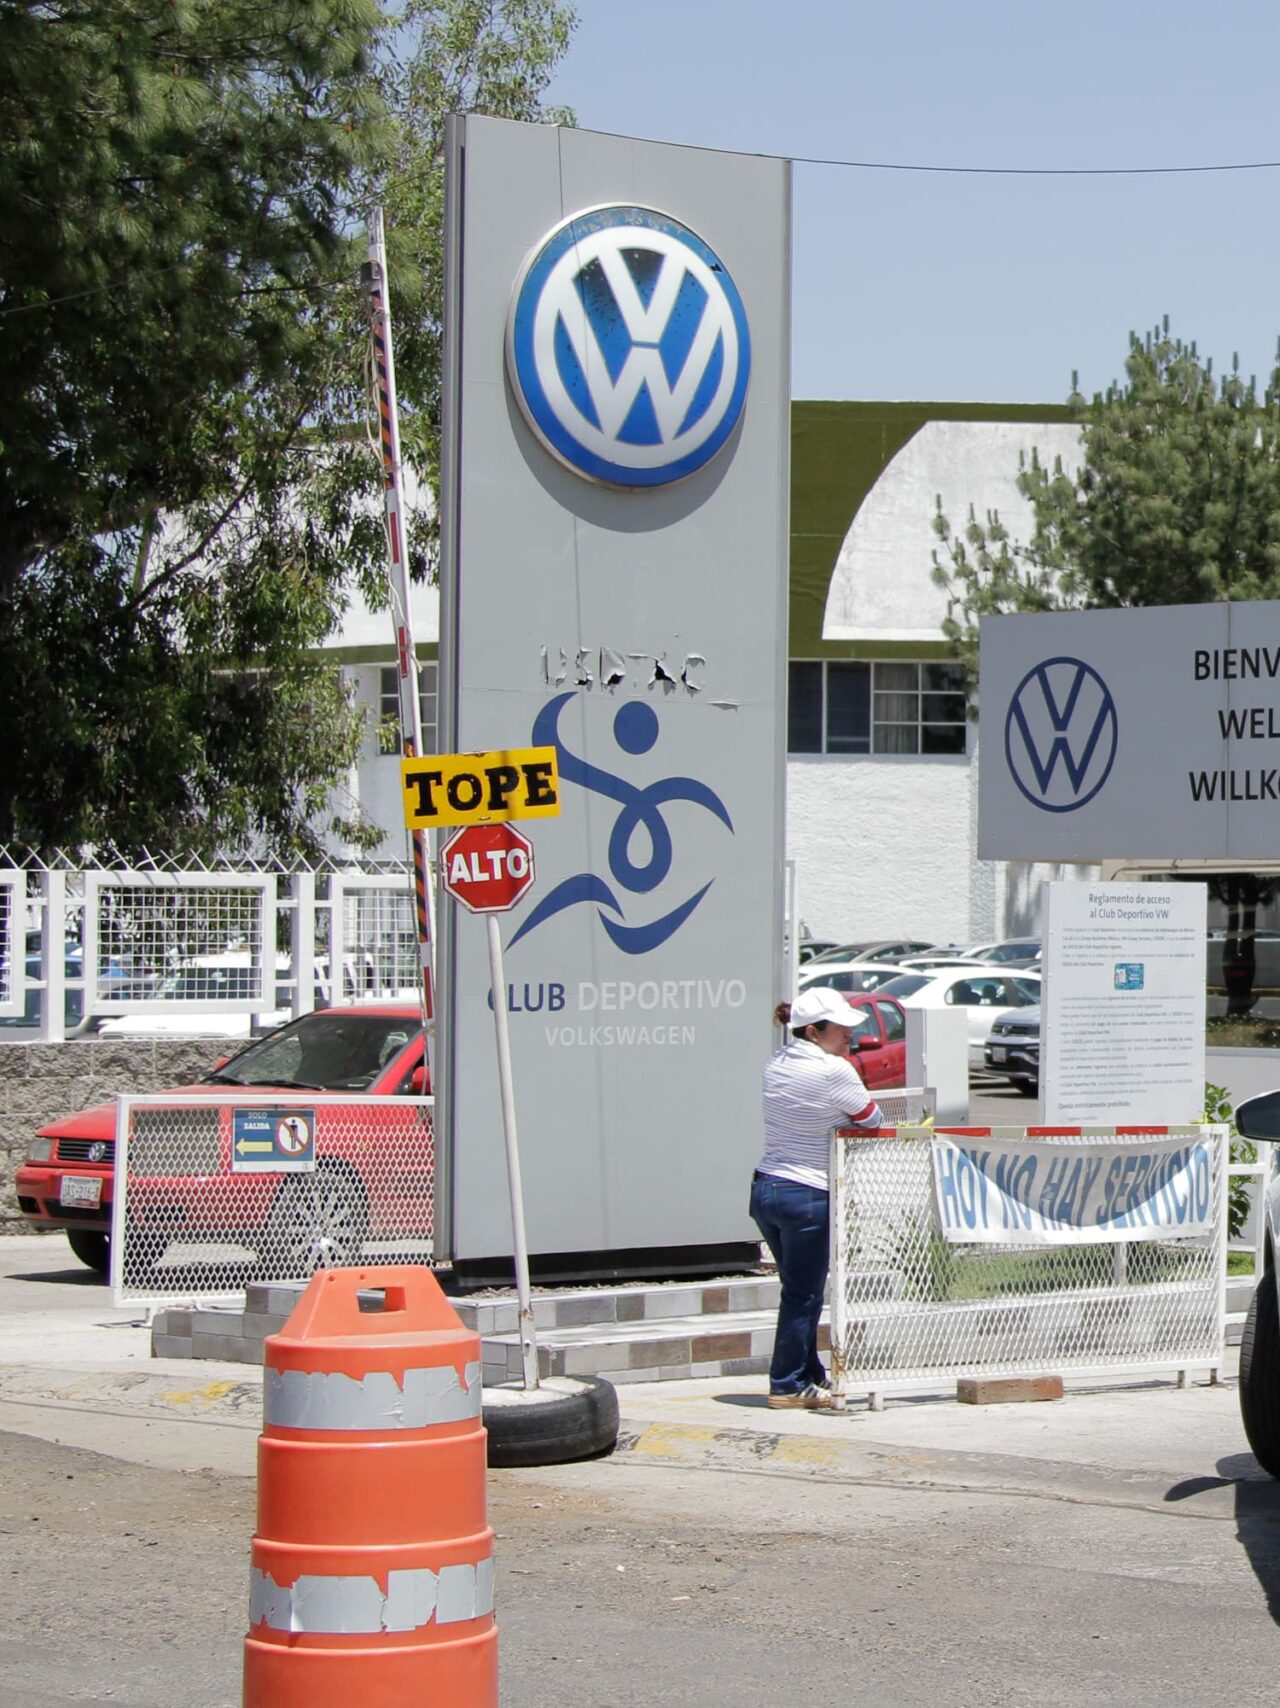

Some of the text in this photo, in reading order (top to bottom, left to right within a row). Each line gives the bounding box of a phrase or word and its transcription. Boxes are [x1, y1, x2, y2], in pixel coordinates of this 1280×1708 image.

[534, 226, 740, 469] VW
[1004, 656, 1119, 814] VW
[405, 761, 558, 818] TOPE
[449, 847, 530, 885] ALTO
[1088, 893, 1171, 906] Reglamento de acceso
[1089, 908, 1169, 921] al Club Deportivo VW
[577, 979, 747, 1012] DEPORTIVO
[544, 1025, 696, 1047] VOLKSWAGEN
[936, 1144, 1209, 1231] HOY NO HAY SERVICIO
